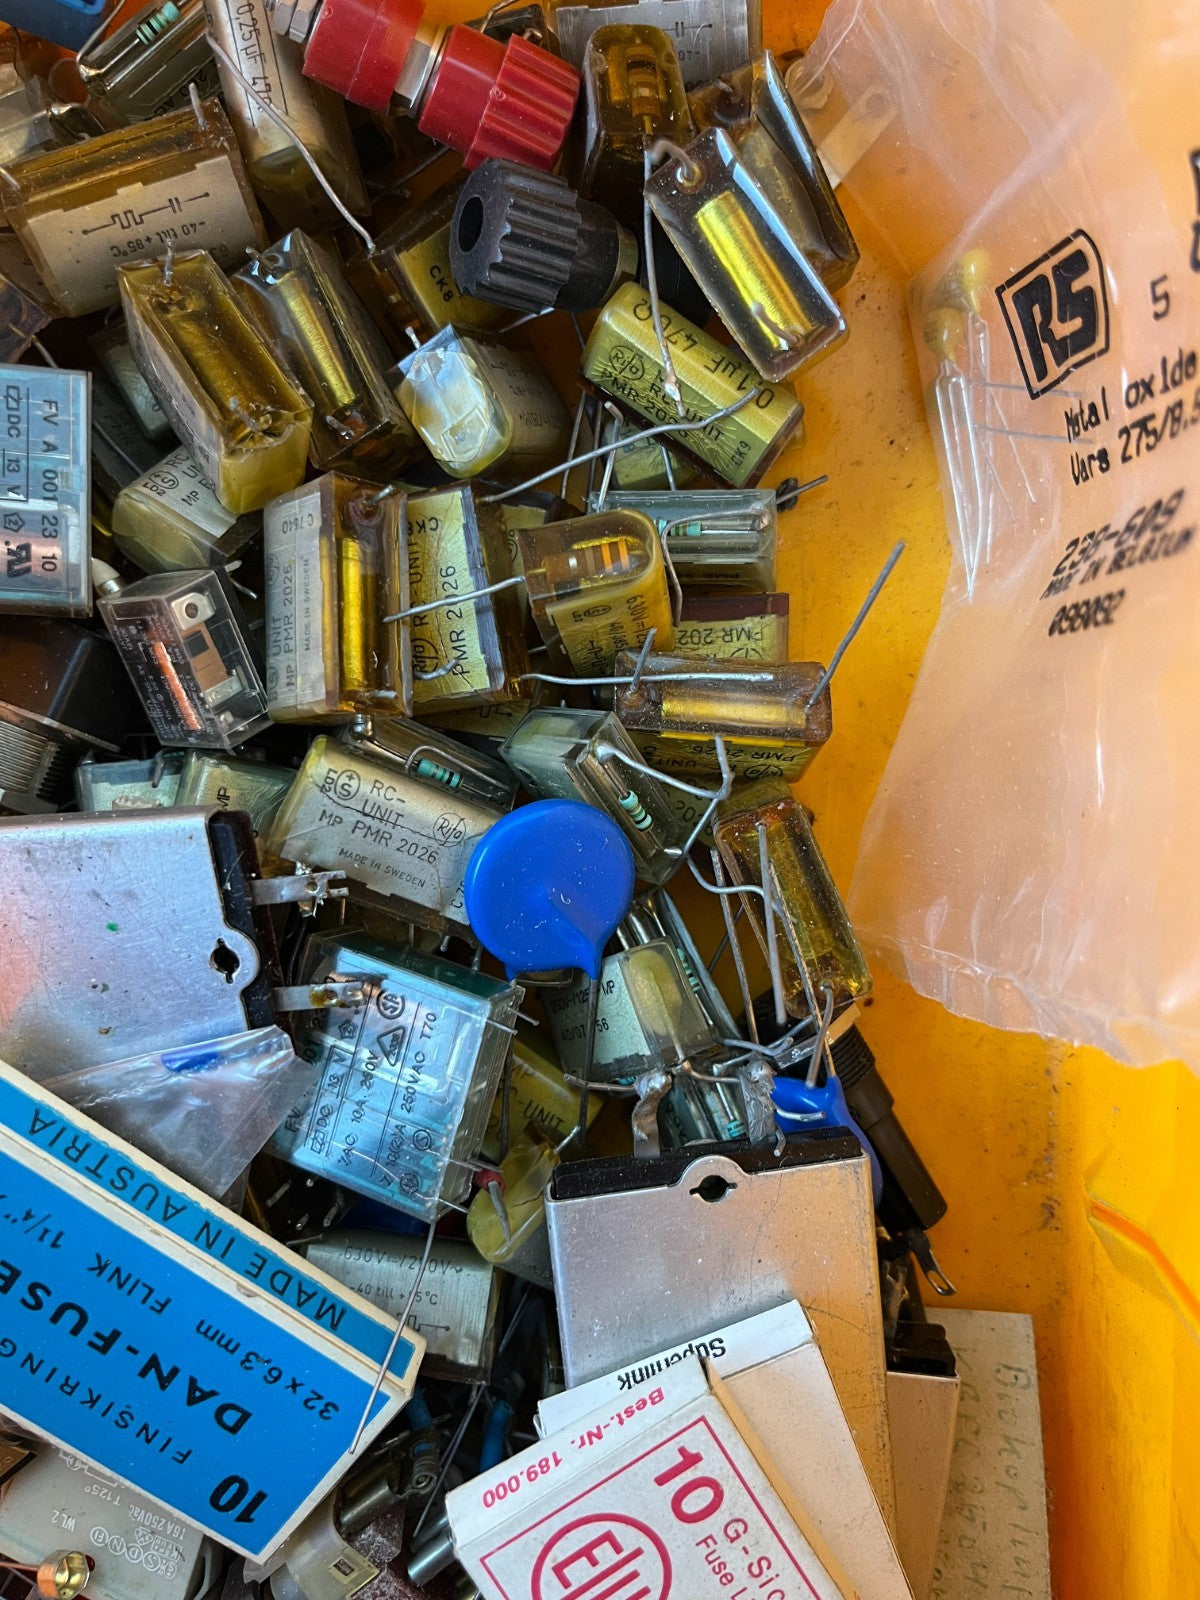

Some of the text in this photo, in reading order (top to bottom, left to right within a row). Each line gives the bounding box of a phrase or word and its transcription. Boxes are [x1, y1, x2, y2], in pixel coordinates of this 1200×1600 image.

[1011, 248, 1100, 385] RS
[1149, 276, 1170, 321] 5
[7, 414, 20, 438] DC
[6, 457, 20, 474] 13
[41, 399, 59, 573] FV A 001 23 10
[181, 490, 202, 507] MP
[272, 616, 284, 658] UNIT
[282, 563, 297, 691] MP PMR 2026
[677, 625, 763, 645] PMR 202
[449, 628, 470, 677] PMR
[319, 767, 338, 794] LD2
[318, 809, 440, 865] MP PMR 2026
[361, 799, 404, 829] UNIT
[436, 816, 466, 847] Rifa
[338, 847, 427, 889] MADE IN SWEDEN
[400, 1050, 427, 1114] 250VAC
[418, 1012, 438, 1041] T70
[317, 1105, 335, 1129] DC
[326, 1074, 342, 1090] 13
[28, 1107, 347, 1331] MADE IN AUSTRIA
[86, 1252, 173, 1316] FLINK
[398, 1289, 440, 1307] +5°C
[0, 1257, 255, 1437] DAN-FUSE
[194, 1317, 242, 1360] mm
[0, 1336, 194, 1468] FINSIKRING
[287, 1377, 311, 1398] x
[303, 1390, 342, 1423] 32
[480, 1385, 667, 1512] Best.-Nr. 189.000
[207, 1471, 271, 1527] 10
[653, 1443, 727, 1526] 10
[695, 1533, 736, 1586] Fuse
